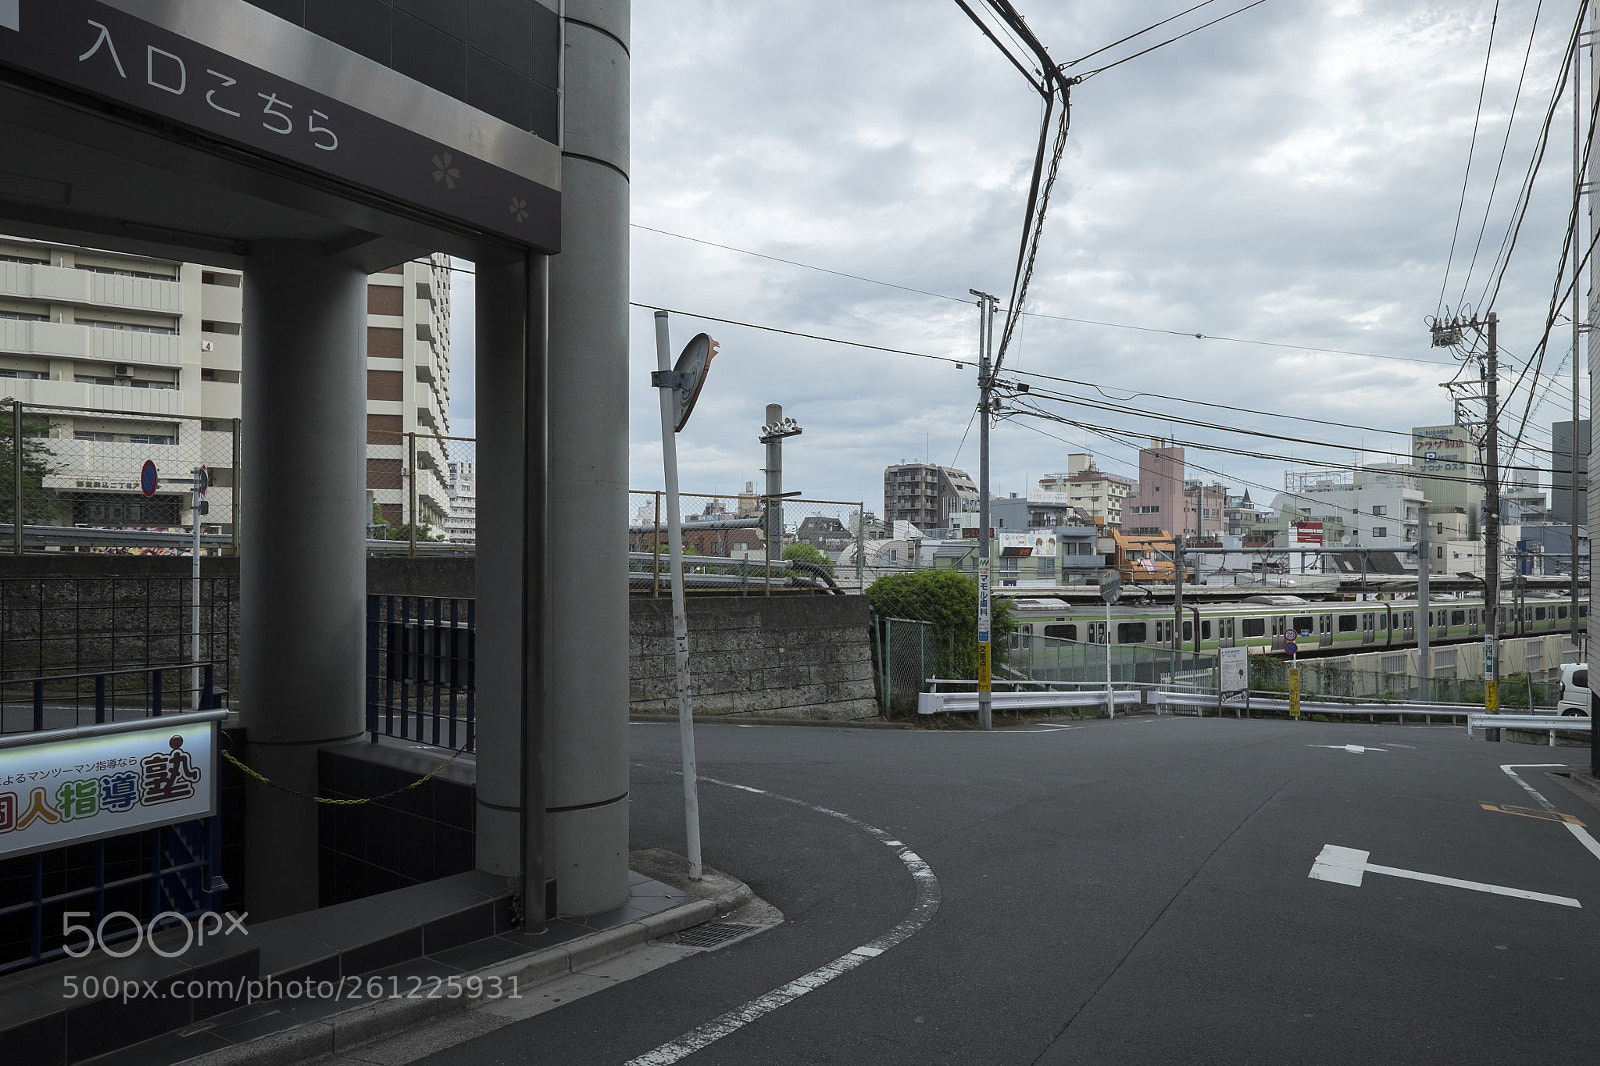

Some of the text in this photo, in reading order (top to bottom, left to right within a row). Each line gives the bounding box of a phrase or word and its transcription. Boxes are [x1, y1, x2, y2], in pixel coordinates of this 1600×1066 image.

[78, 19, 340, 152] 入口こちら
[979, 574, 988, 617] マモル歯科
